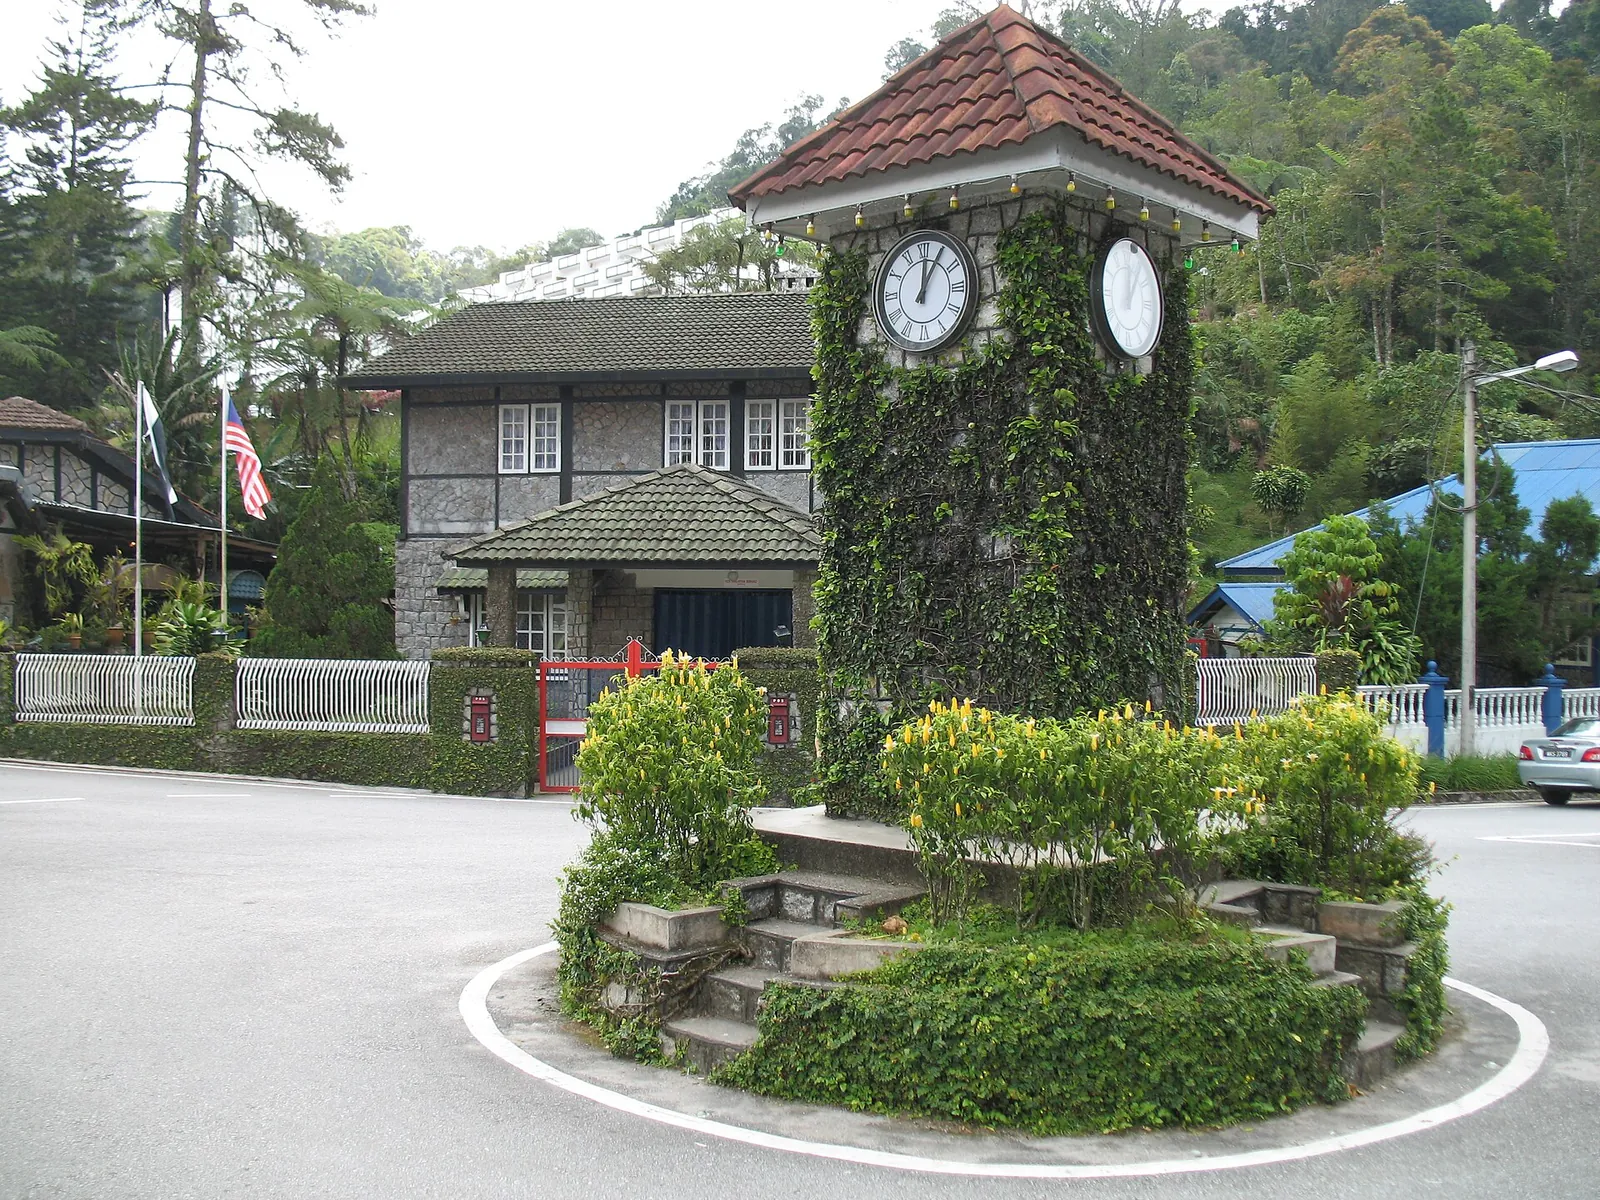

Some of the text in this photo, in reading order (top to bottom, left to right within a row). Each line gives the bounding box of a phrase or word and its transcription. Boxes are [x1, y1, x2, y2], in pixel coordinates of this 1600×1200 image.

[902, 250, 914, 266] XI
[917, 243, 930, 258] XII
[946, 258, 960, 273] II
[889, 269, 902, 281] X
[952, 280, 964, 293] III
[885, 291, 898, 302] IX
[888, 308, 903, 325] VIII
[947, 303, 961, 317] IV
[901, 321, 913, 338] VII
[919, 325, 930, 341] VI
[937, 319, 947, 334] V
